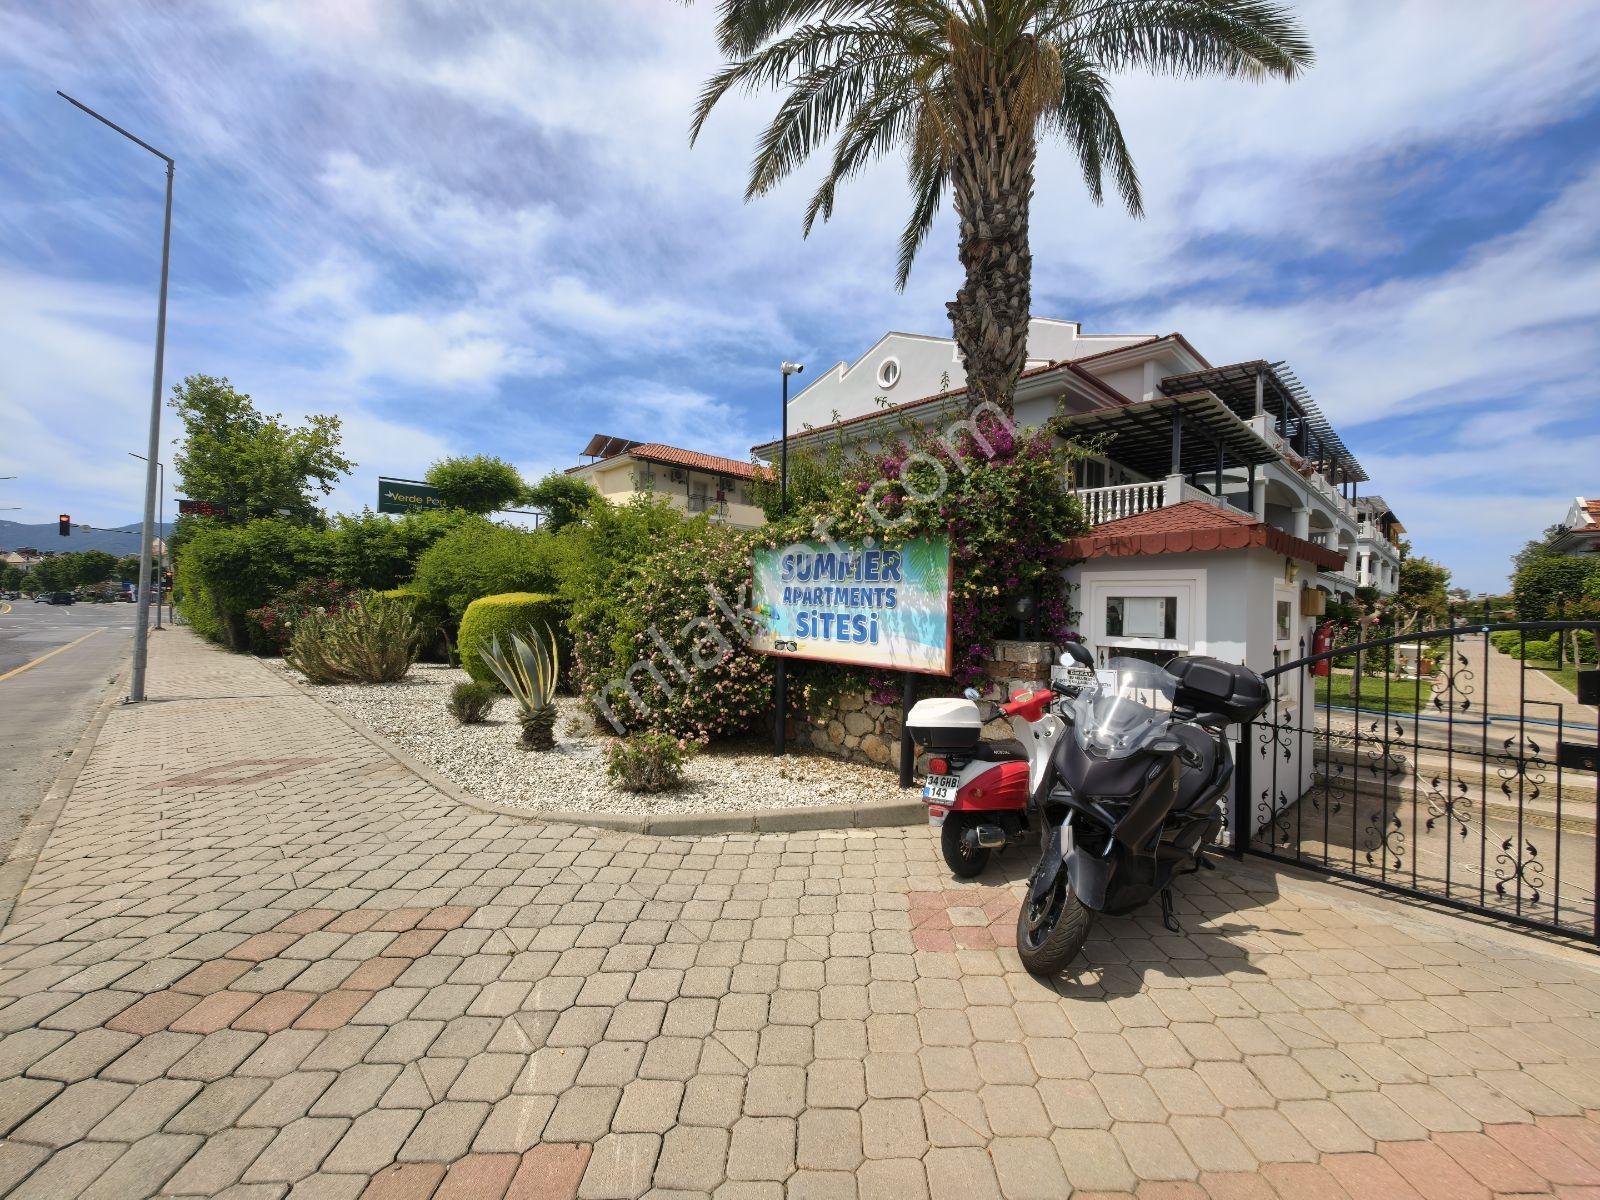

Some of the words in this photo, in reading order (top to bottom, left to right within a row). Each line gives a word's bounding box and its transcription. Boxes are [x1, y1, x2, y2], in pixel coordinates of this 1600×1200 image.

[392, 492, 422, 504] Verde
[781, 550, 903, 582] SUMMER
[782, 586, 897, 609] APARTMENTS
[927, 776, 939, 785] 34
[940, 776, 957, 788] GHB
[931, 787, 947, 798] 143
